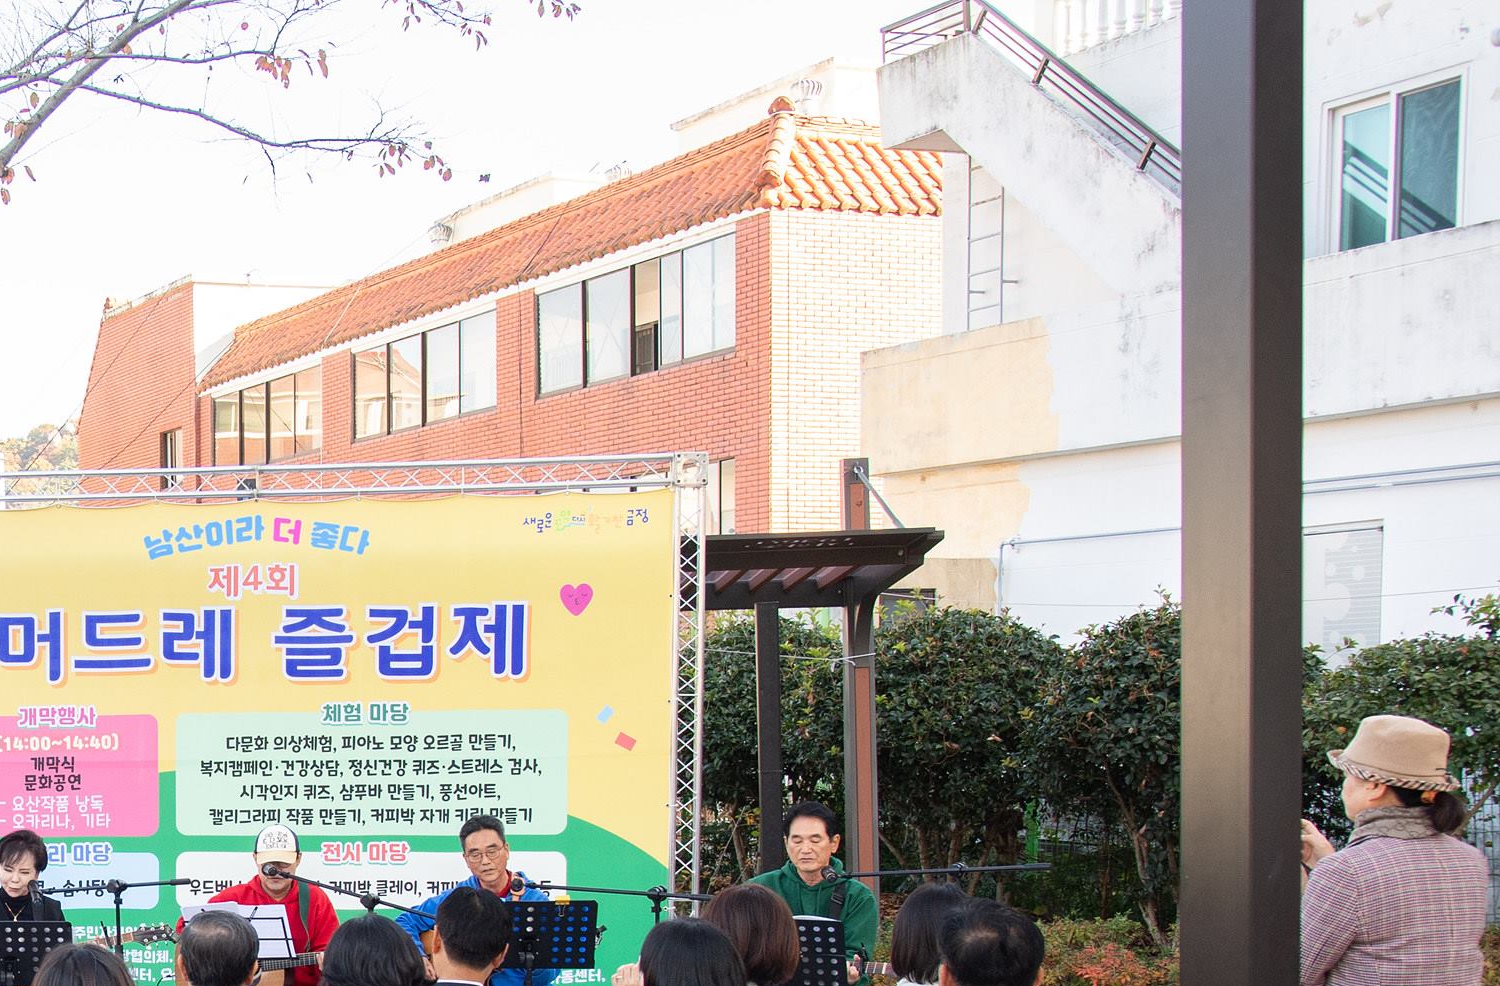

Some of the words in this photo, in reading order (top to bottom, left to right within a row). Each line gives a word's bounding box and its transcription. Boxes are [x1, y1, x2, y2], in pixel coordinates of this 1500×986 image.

[523, 512, 552, 533] 새로운
[626, 508, 649, 526] 금정
[143, 514, 265, 560] 남산이라
[273, 517, 302, 545] 더
[310, 521, 370, 555] 좋다
[208, 565, 295, 597] 제4회
[273, 604, 528, 680] 즐겁제
[19, 707, 96, 726] 개막행사
[322, 703, 361, 722] 체험
[369, 703, 409, 722] 마당
[226, 736, 269, 751] 다문화
[273, 735, 337, 753] 의상체험,
[342, 735, 385, 750] 피아노
[390, 735, 418, 752] 모양
[423, 734, 463, 751] 오르골
[468, 734, 516, 751] 만들기,
[30, 756, 75, 773] 개막식
[348, 759, 407, 777] 정신건강
[508, 758, 542, 776] 검사,
[24, 774, 82, 791] 문화공연
[240, 784, 298, 800] 시각인지
[303, 785, 335, 802] 퀴즈,
[339, 784, 382, 800] 샴푸바
[387, 784, 434, 801] 만들기,
[439, 783, 501, 801] 풍선아트,
[12, 795, 69, 813] 요산작품
[75, 795, 104, 813] 낭독
[12, 813, 75, 831] 오카리나,
[81, 813, 111, 829] 기타
[209, 808, 281, 825] 캘리그라피
[286, 808, 314, 825] 작품
[319, 808, 366, 825] 만들기,
[370, 808, 415, 825] 커피박
[420, 808, 449, 824] 자개
[73, 844, 111, 863] 마당
[322, 843, 360, 862] 전시
[369, 843, 408, 862] 마당
[190, 879, 242, 895] 우드버
[376, 880, 422, 898] 클레이,
